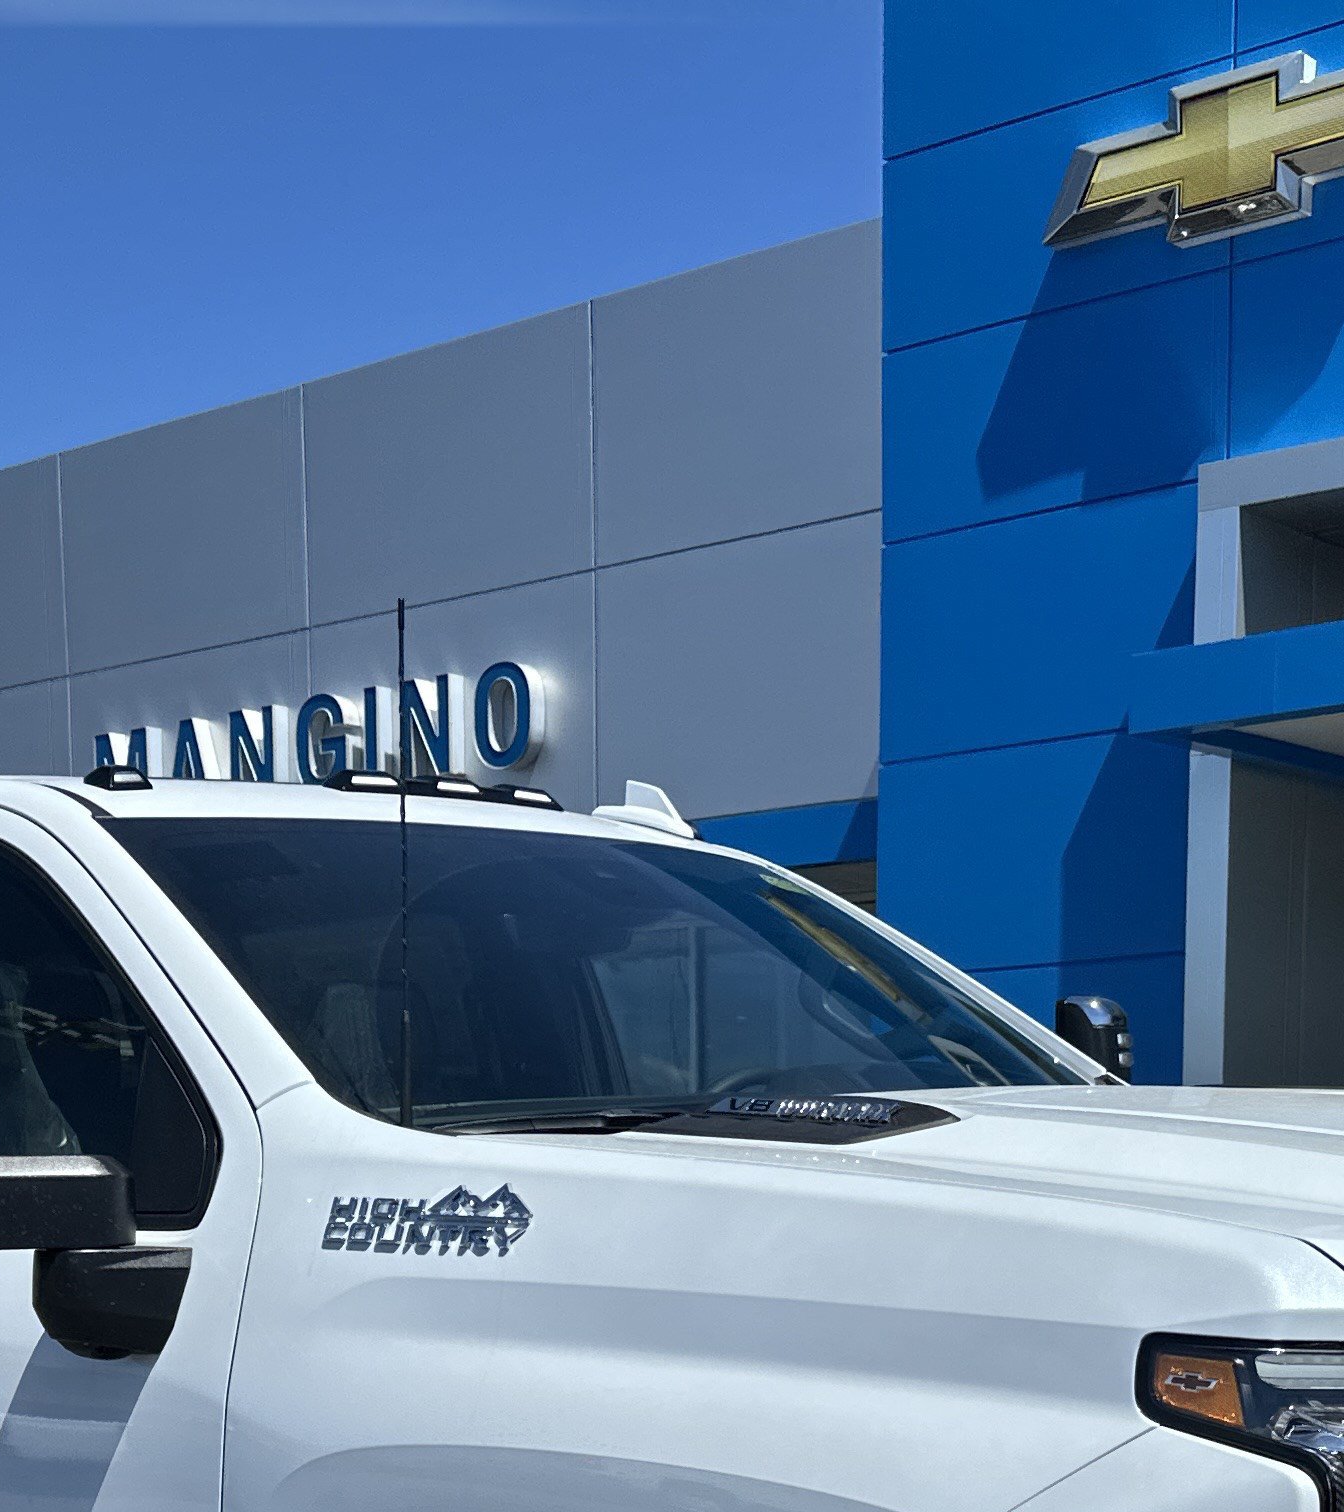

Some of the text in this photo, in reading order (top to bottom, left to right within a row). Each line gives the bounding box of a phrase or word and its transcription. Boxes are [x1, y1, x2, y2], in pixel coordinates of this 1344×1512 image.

[729, 1097, 773, 1112] V8
[328, 1196, 431, 1223] HIGH
[321, 1222, 529, 1257] COUNTRY
